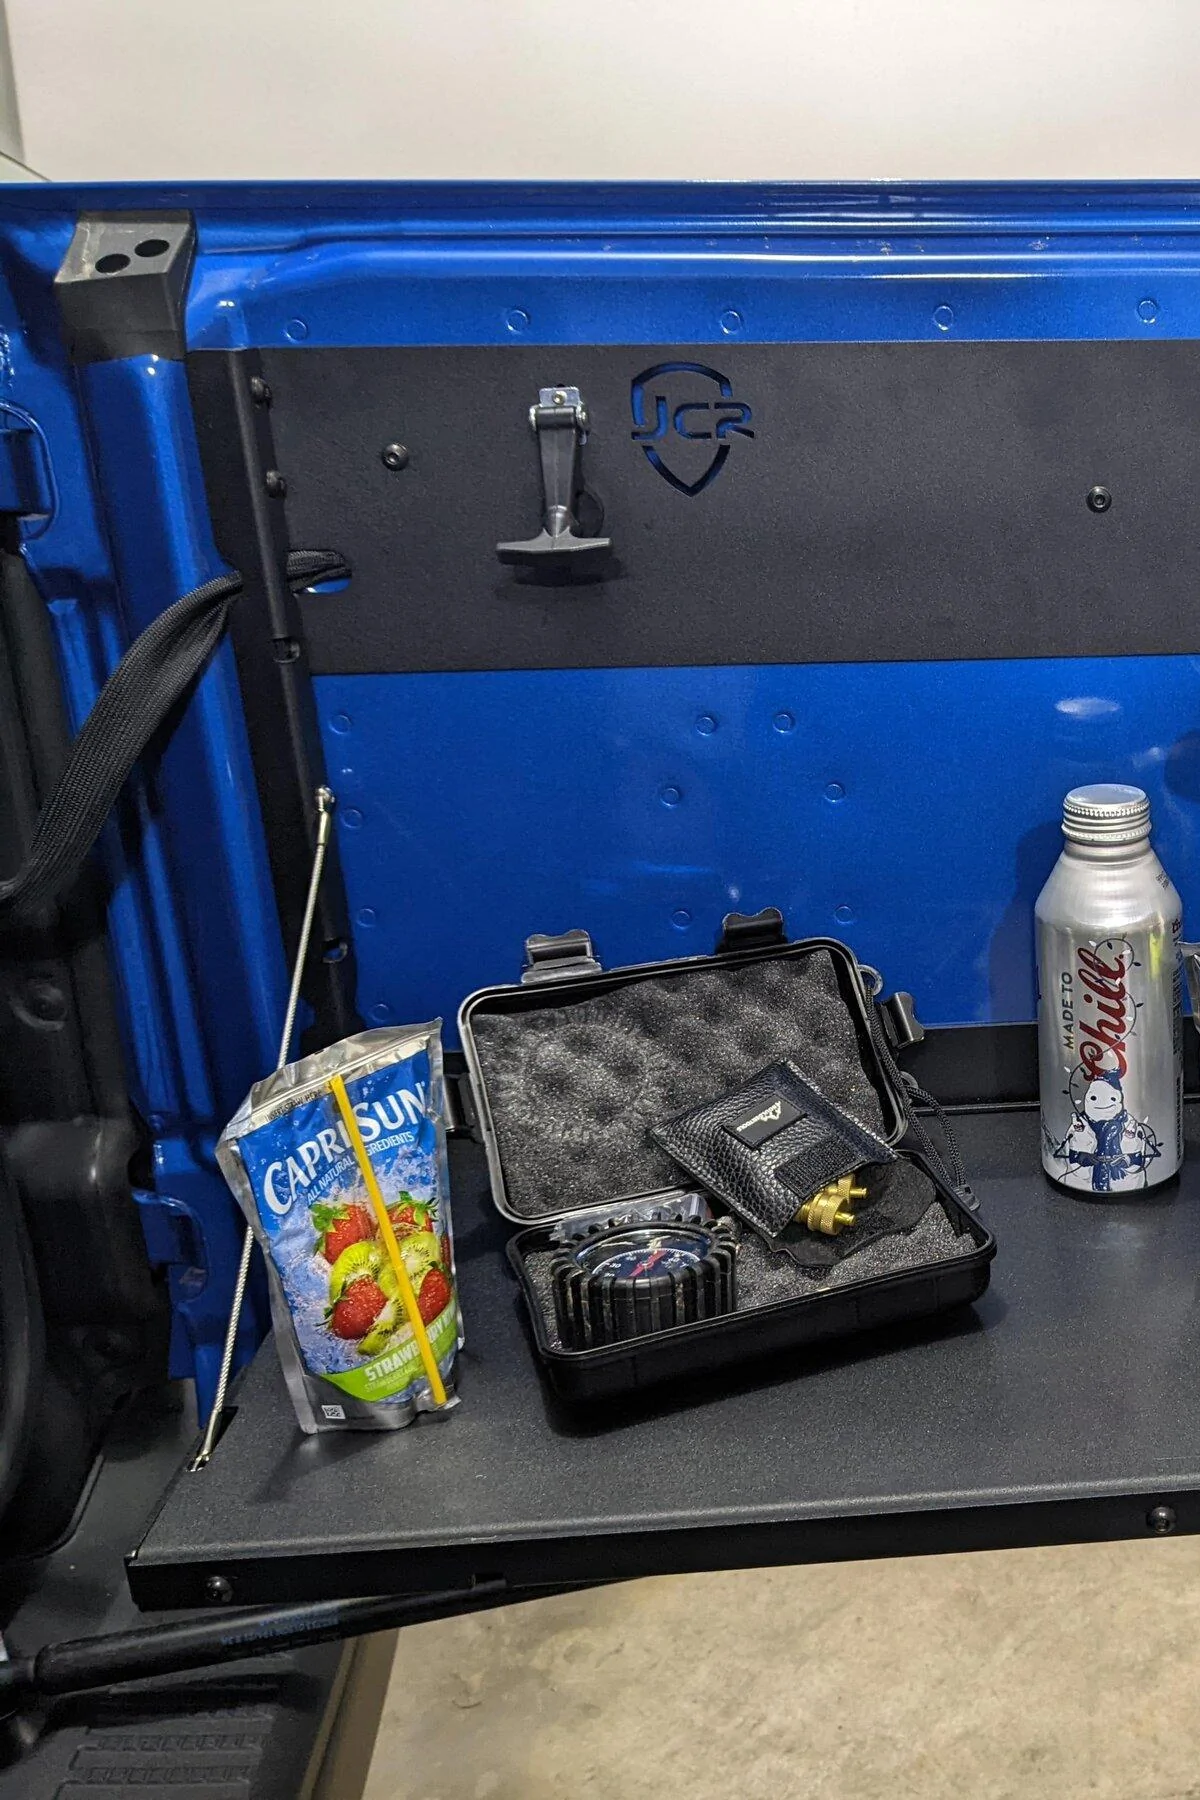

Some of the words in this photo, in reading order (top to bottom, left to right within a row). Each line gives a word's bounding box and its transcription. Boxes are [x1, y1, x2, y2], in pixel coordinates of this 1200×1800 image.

[631, 396, 754, 440] JCR
[1061, 971, 1073, 995] TO
[1062, 999, 1076, 1050] MADE
[306, 1182, 322, 1204] ALL
[319, 1154, 355, 1186] NATURAL
